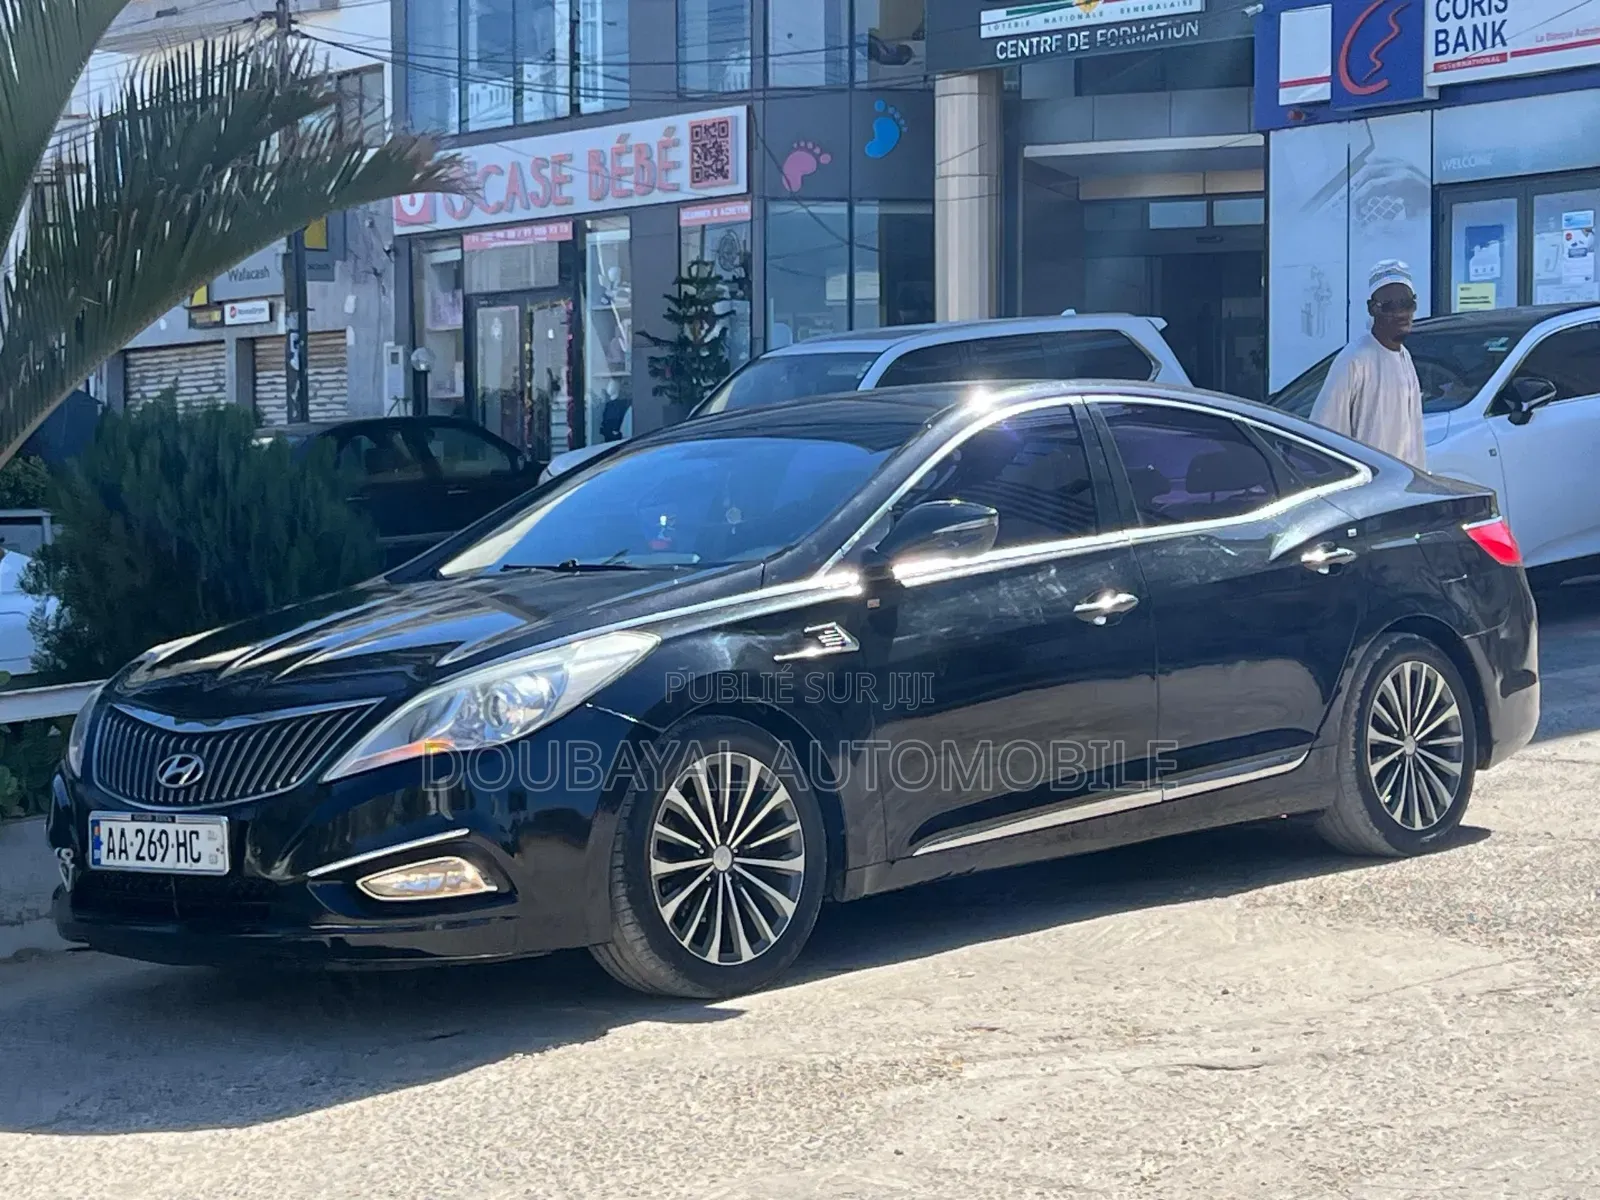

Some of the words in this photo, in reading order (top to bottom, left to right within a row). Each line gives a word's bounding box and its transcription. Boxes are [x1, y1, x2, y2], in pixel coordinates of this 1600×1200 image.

[987, 20, 1030, 32] LOTERIE
[1044, 10, 1104, 25] NATIONALE
[1435, 0, 1508, 23] CORIS
[996, 34, 1063, 60] CENTRE
[1067, 31, 1090, 51] DE
[1096, 19, 1199, 48] FORMATION
[1434, 19, 1508, 56] BANK
[587, 125, 682, 202] BÉBÉ
[227, 265, 270, 283] Wafacash
